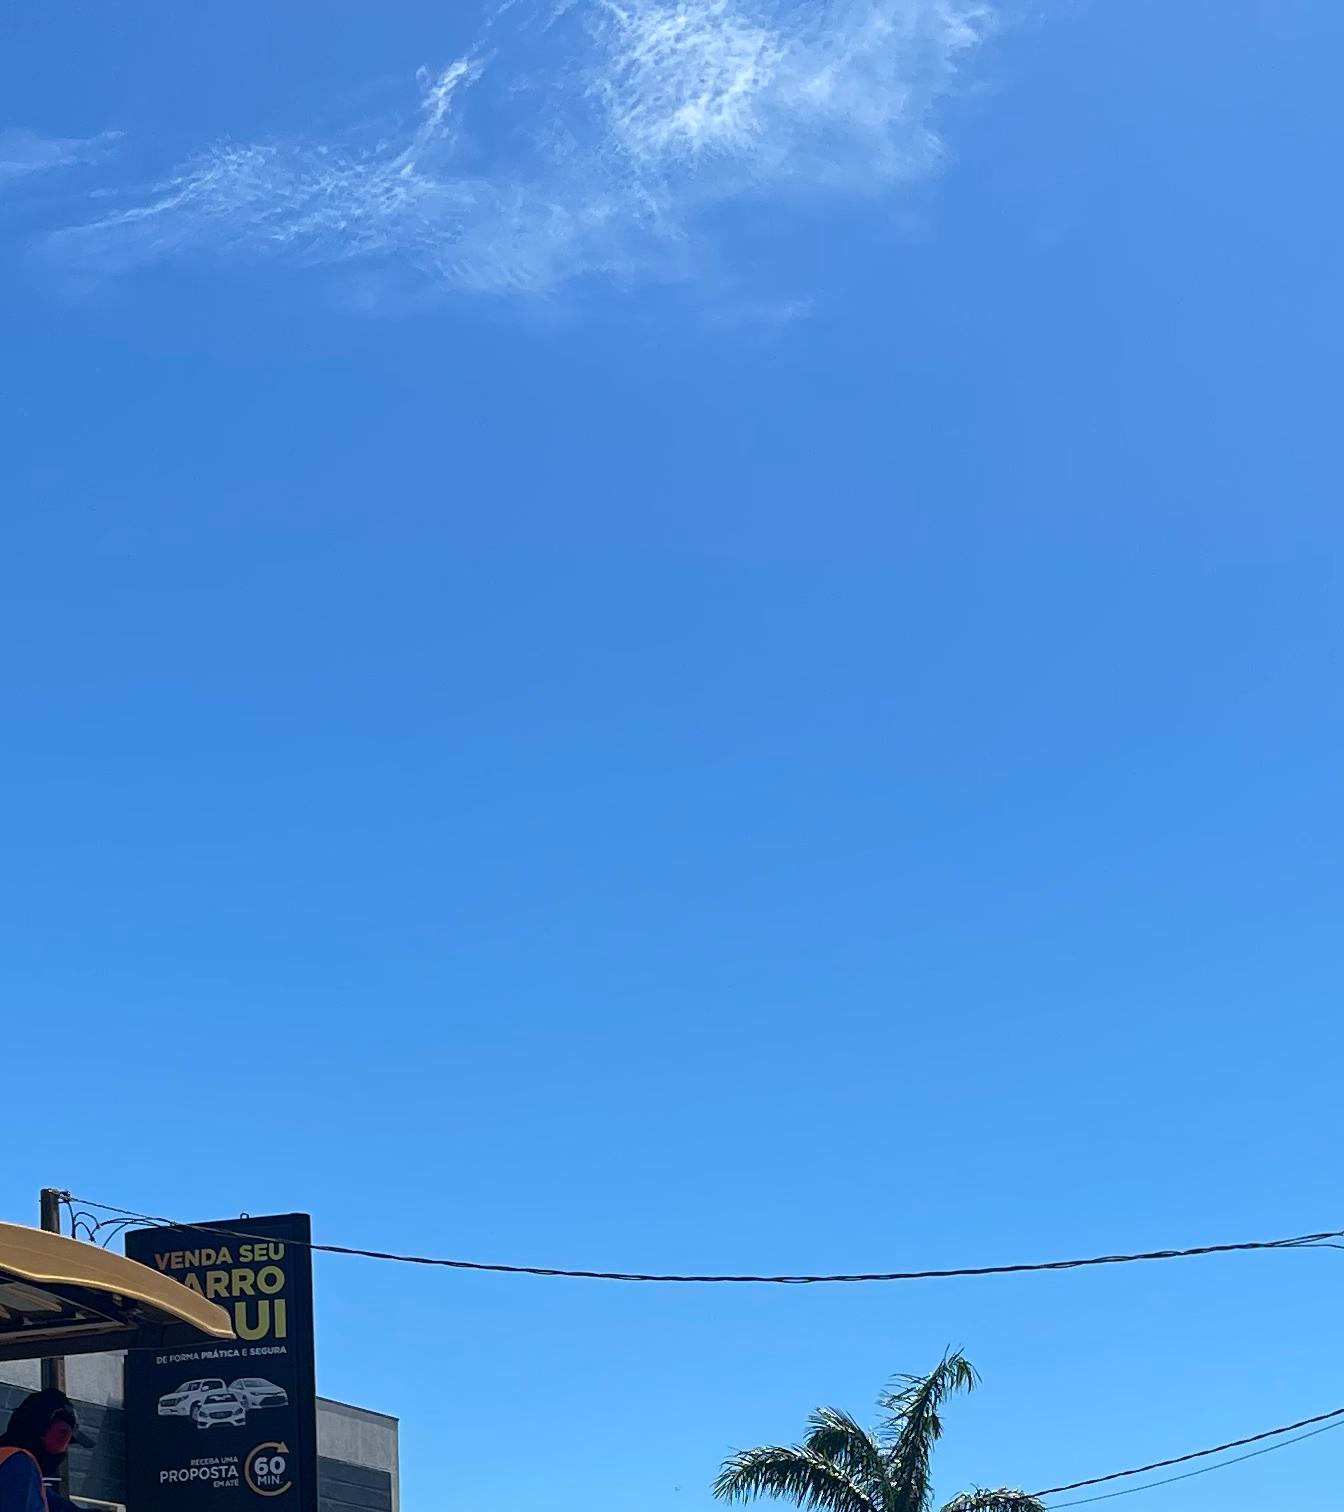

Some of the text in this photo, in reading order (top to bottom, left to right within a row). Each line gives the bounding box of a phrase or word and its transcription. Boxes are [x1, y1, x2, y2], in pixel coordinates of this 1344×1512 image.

[155, 1243, 285, 1271] VENDA SEU
[167, 1265, 285, 1299] ARRO
[156, 1345, 287, 1364] DE FORMA PRÁTICA E SEGURA
[190, 1458, 220, 1466] RECEBA
[254, 1456, 286, 1476] 60
[159, 1465, 239, 1483] PROPOSTA
